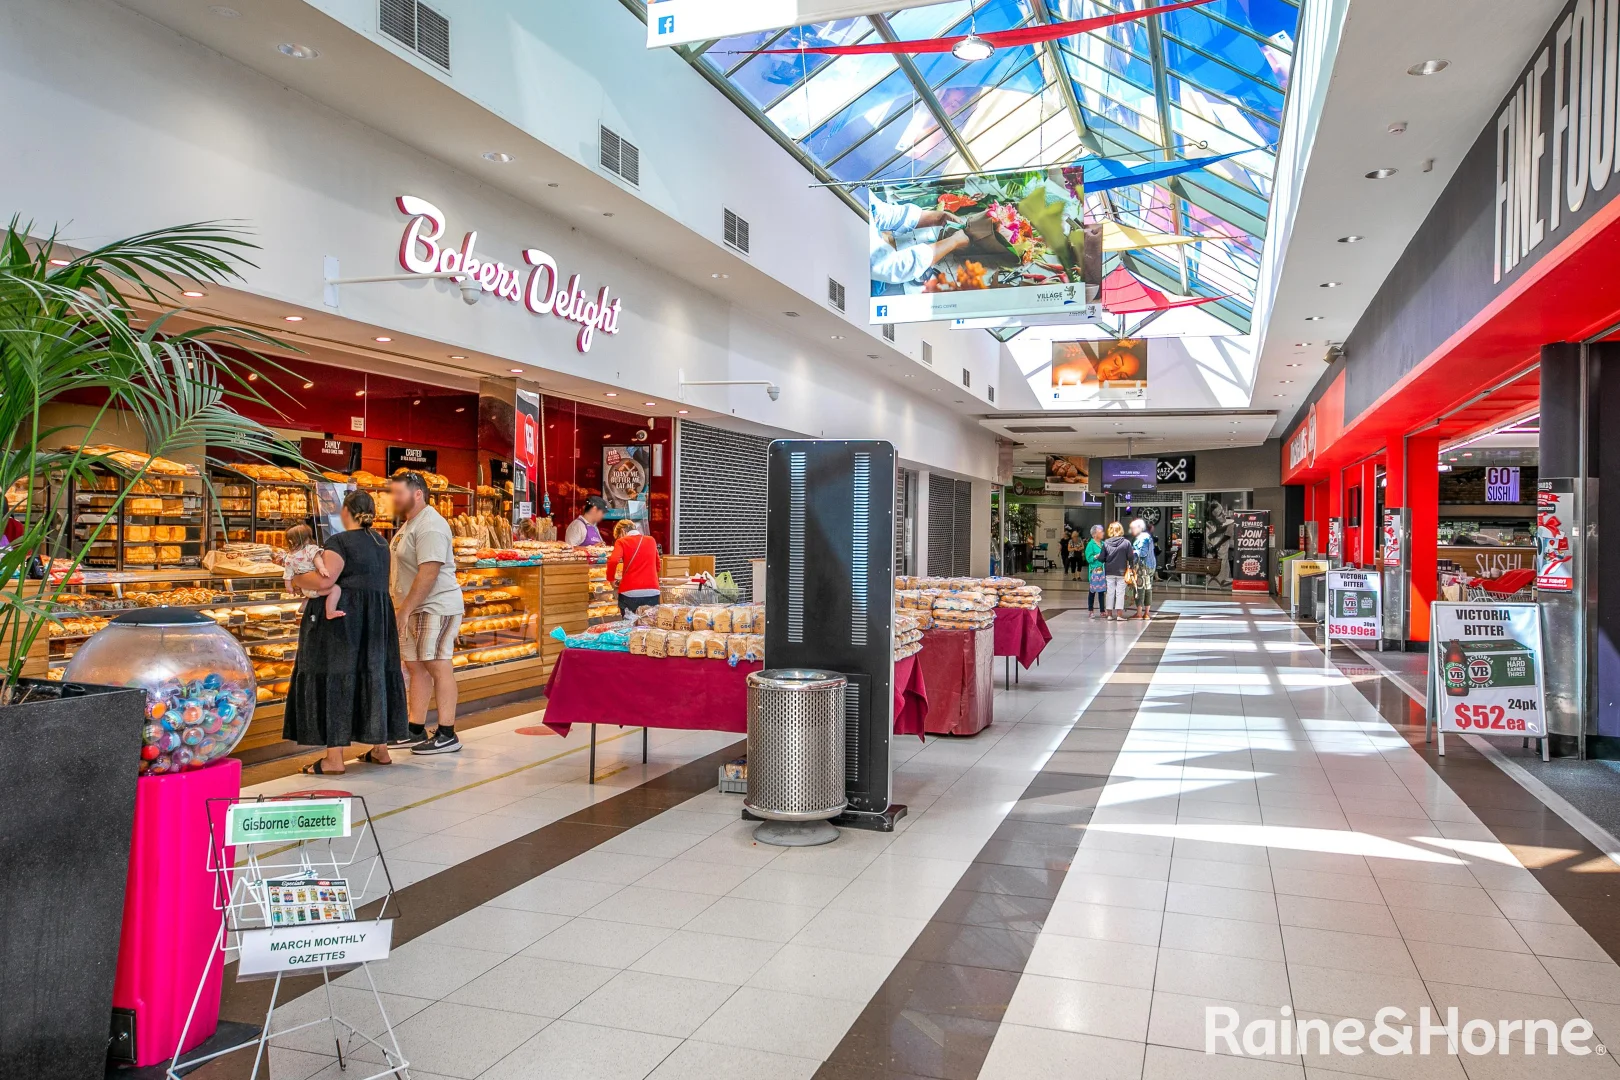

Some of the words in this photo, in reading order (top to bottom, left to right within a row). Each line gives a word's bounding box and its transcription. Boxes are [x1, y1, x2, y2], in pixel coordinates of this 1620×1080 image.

[1494, 46, 1549, 285] FINE
[396, 195, 522, 302] Bakers
[522, 248, 622, 353] Delight
[324, 440, 341, 450] FAMILY
[405, 448, 423, 458] CRAFTED
[1488, 468, 1510, 485] GO
[1488, 486, 1511, 501] SUSHI
[1241, 530, 1263, 538] JOIN
[1237, 539, 1266, 547] TODAY
[1456, 609, 1511, 621] VICTORIA
[1329, 624, 1376, 636] $59.99ea
[1464, 625, 1504, 636] BITTER
[1507, 660, 1526, 668] HARD
[1470, 667, 1489, 676] VB
[1508, 699, 1537, 711] 24pk
[243, 817, 290, 831] Gisborne
[298, 815, 337, 828] Gazette
[270, 939, 311, 951] MARCH
[314, 934, 366, 947] MONTHLY
[288, 951, 346, 964] GAZETTES
